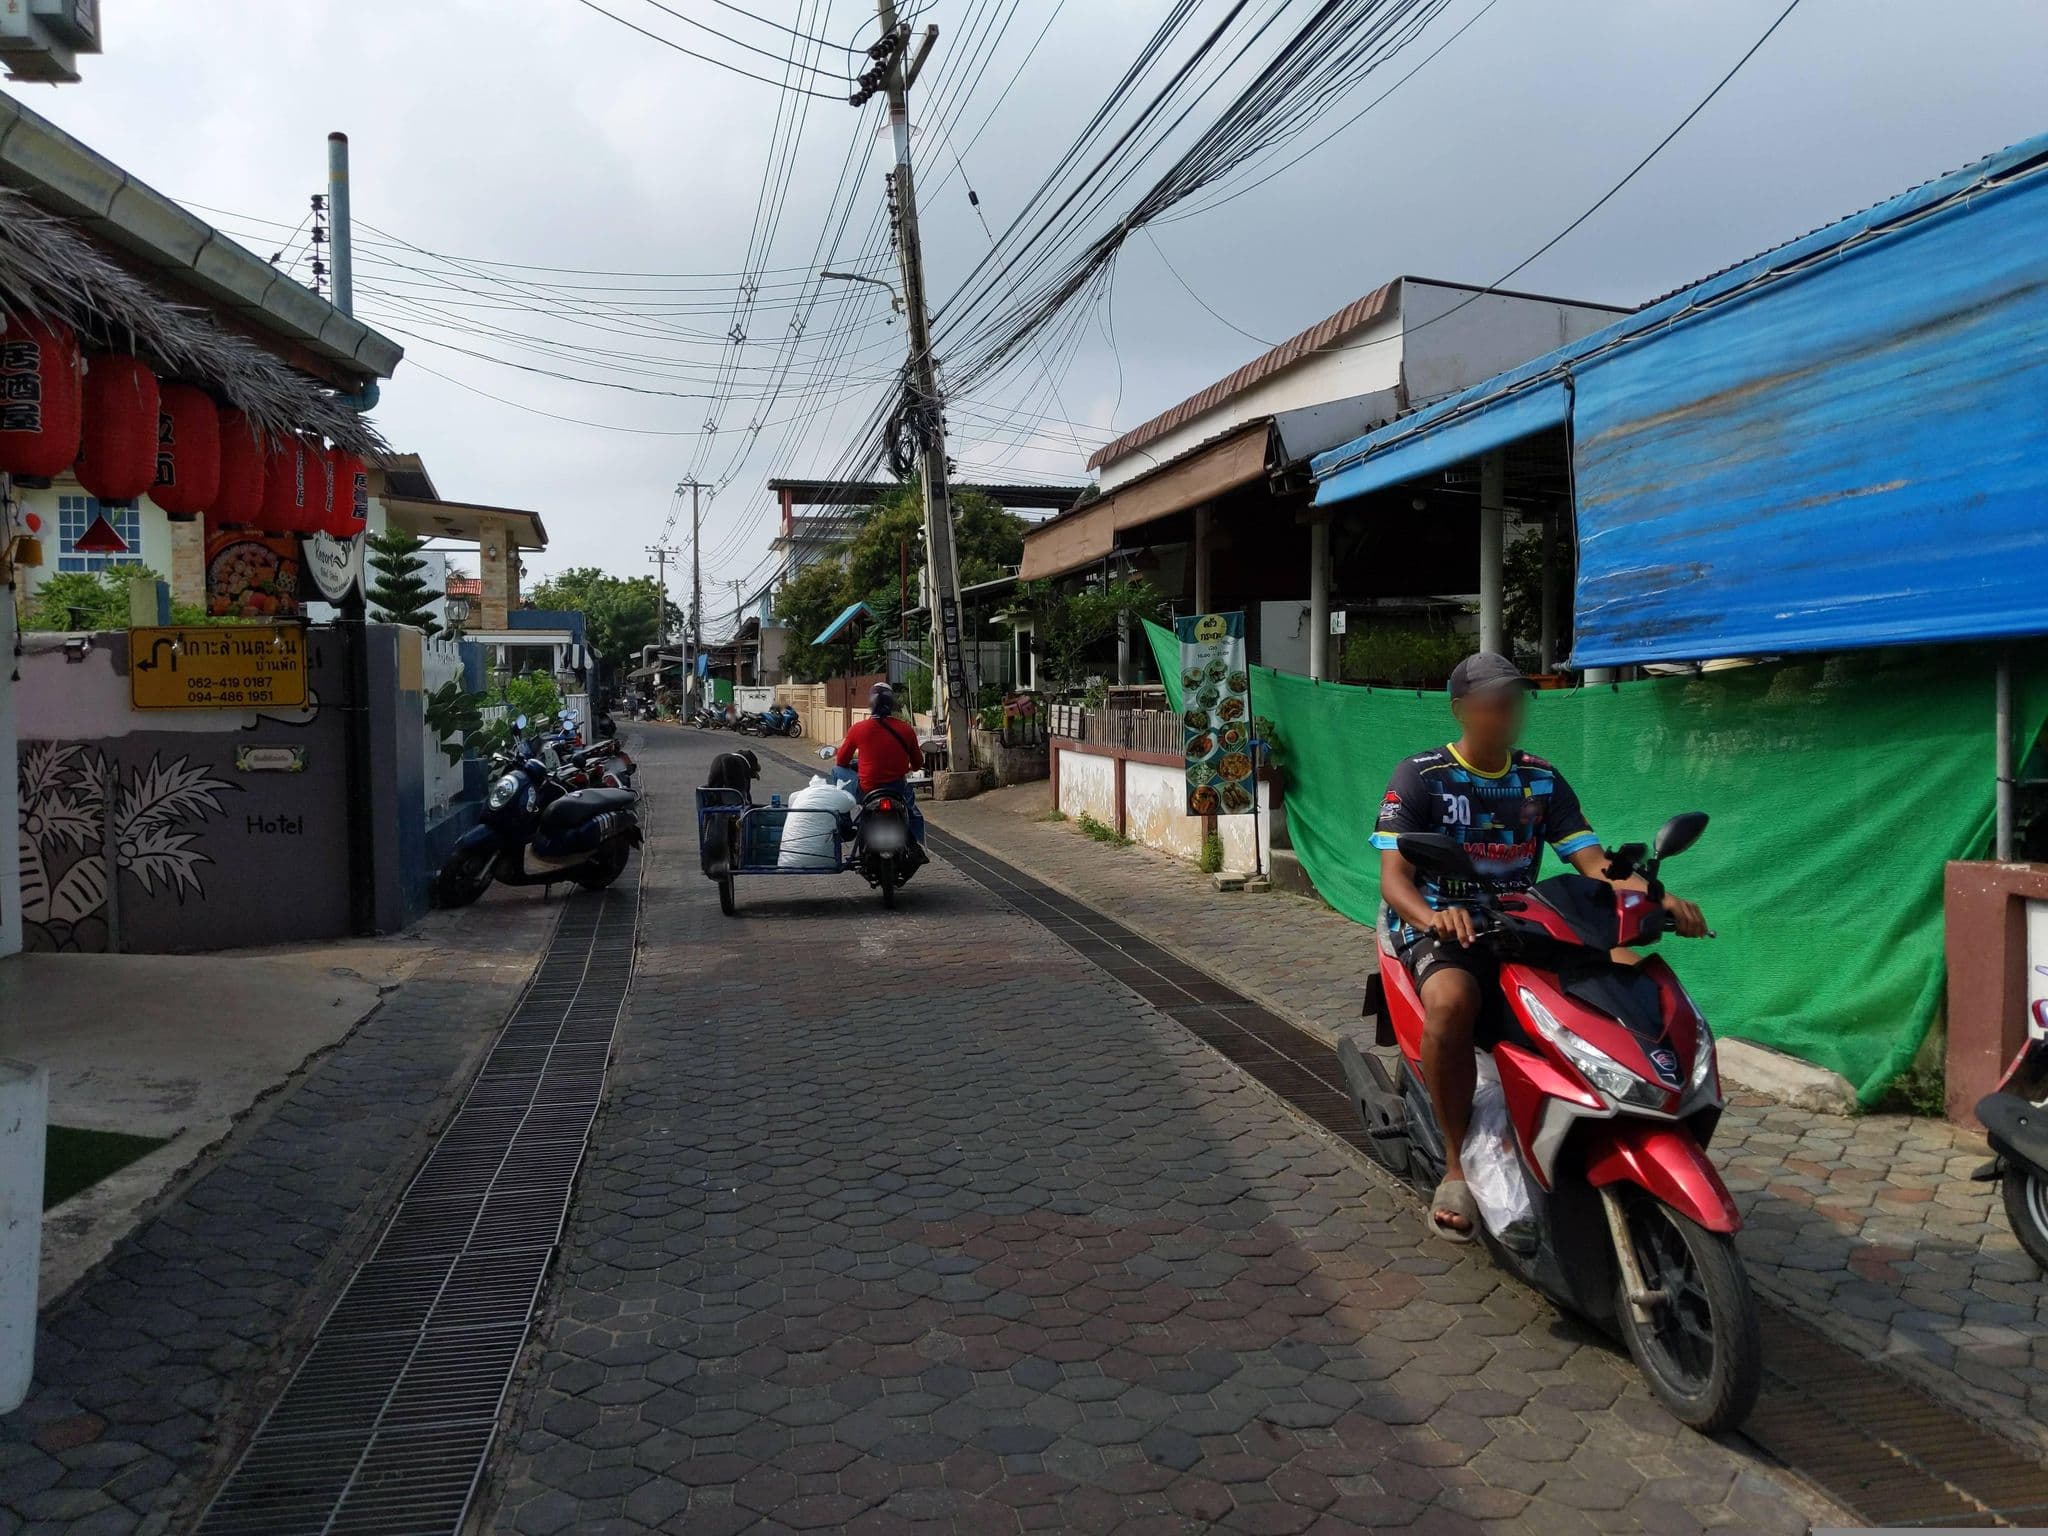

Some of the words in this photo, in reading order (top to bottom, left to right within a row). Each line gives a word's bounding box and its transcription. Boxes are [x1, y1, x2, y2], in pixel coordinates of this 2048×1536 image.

[184, 633, 297, 656] เกาะล้านตะน
[256, 656, 297, 672] บ้านพัก
[187, 677, 240, 688] 062-419
[243, 677, 273, 688] 0187
[187, 691, 244, 702] 094-486
[247, 691, 273, 702] 1951
[1443, 794, 1470, 826] 30
[246, 815, 303, 834] Hotel
